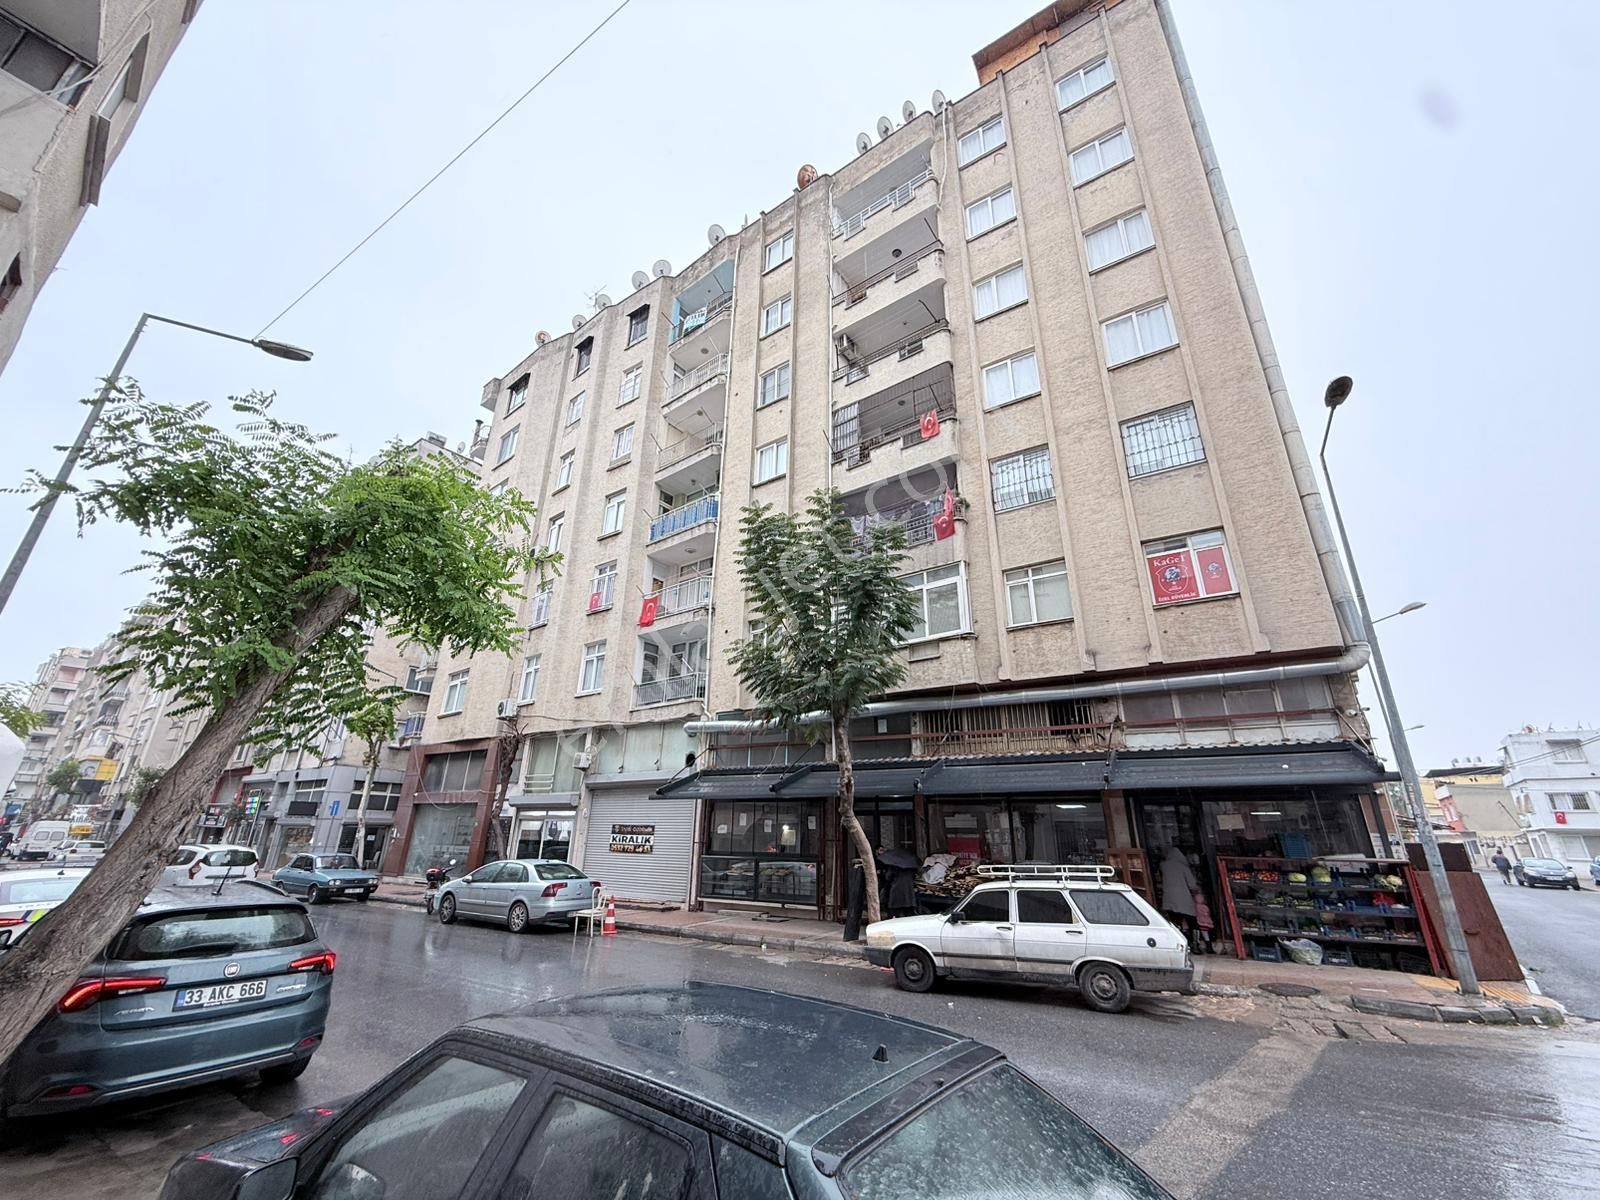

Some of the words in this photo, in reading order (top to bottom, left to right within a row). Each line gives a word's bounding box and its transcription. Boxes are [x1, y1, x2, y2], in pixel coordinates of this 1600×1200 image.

[185, 990, 204, 1004] 33
[208, 985, 235, 1001] AKC
[240, 982, 264, 997] 666
